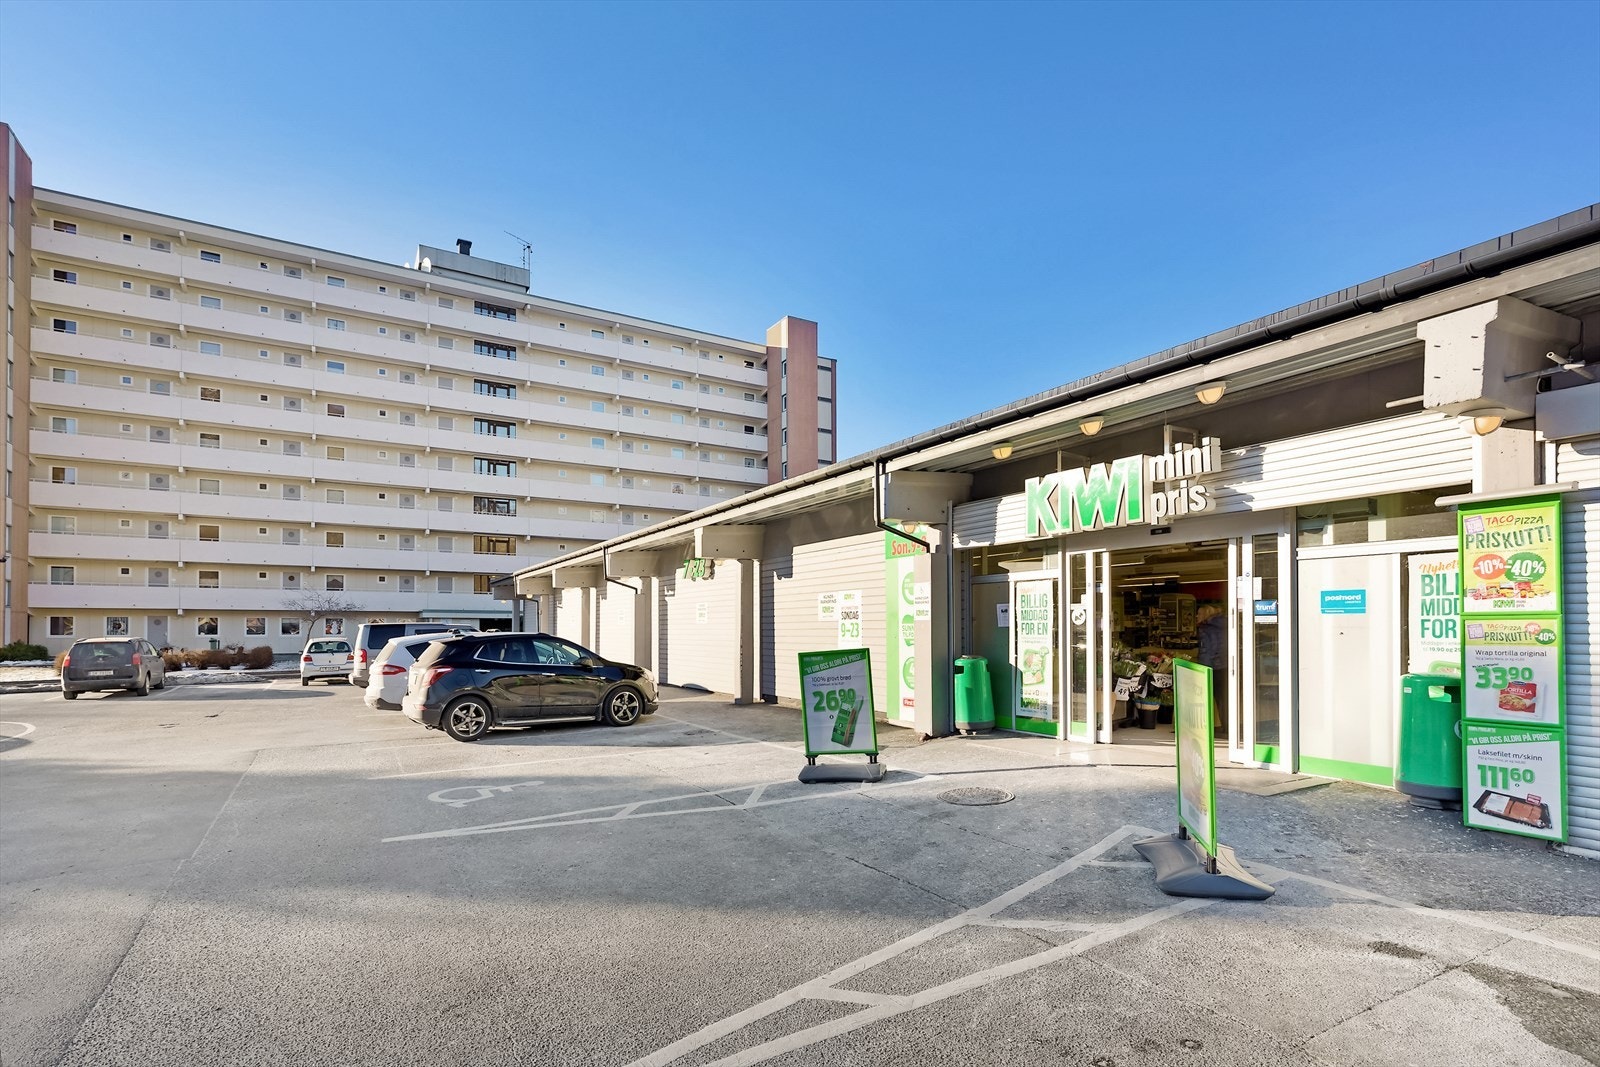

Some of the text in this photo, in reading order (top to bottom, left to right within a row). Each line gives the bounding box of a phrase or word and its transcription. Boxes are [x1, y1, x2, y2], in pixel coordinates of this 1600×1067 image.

[1149, 437, 1212, 481] mini
[1025, 454, 1144, 537] KIWI
[1151, 480, 1207, 525] pris
[1486, 515, 1514, 526] TACO
[1514, 516, 1544, 525] PIZZA
[1466, 525, 1552, 549] PRISKUTT!
[1473, 559, 1545, 576] -10% -40%
[1020, 594, 1048, 608] BILLIG
[1020, 609, 1048, 622] MIDDAG
[841, 622, 859, 638] 9-23
[1021, 622, 1048, 636] FOR EN
[1421, 618, 1457, 639] FOR
[1486, 623, 1503, 631] TACO
[1484, 631, 1532, 642] PRISKUTT!
[1535, 632, 1556, 642] -40%
[1475, 650, 1493, 658] Wrap
[1519, 650, 1547, 658] original
[1503, 735, 1521, 743] ALDRI
[1522, 733, 1532, 741] PÅ
[1477, 749, 1511, 758] Laksefilet
[1512, 753, 1543, 762] m/skinn
